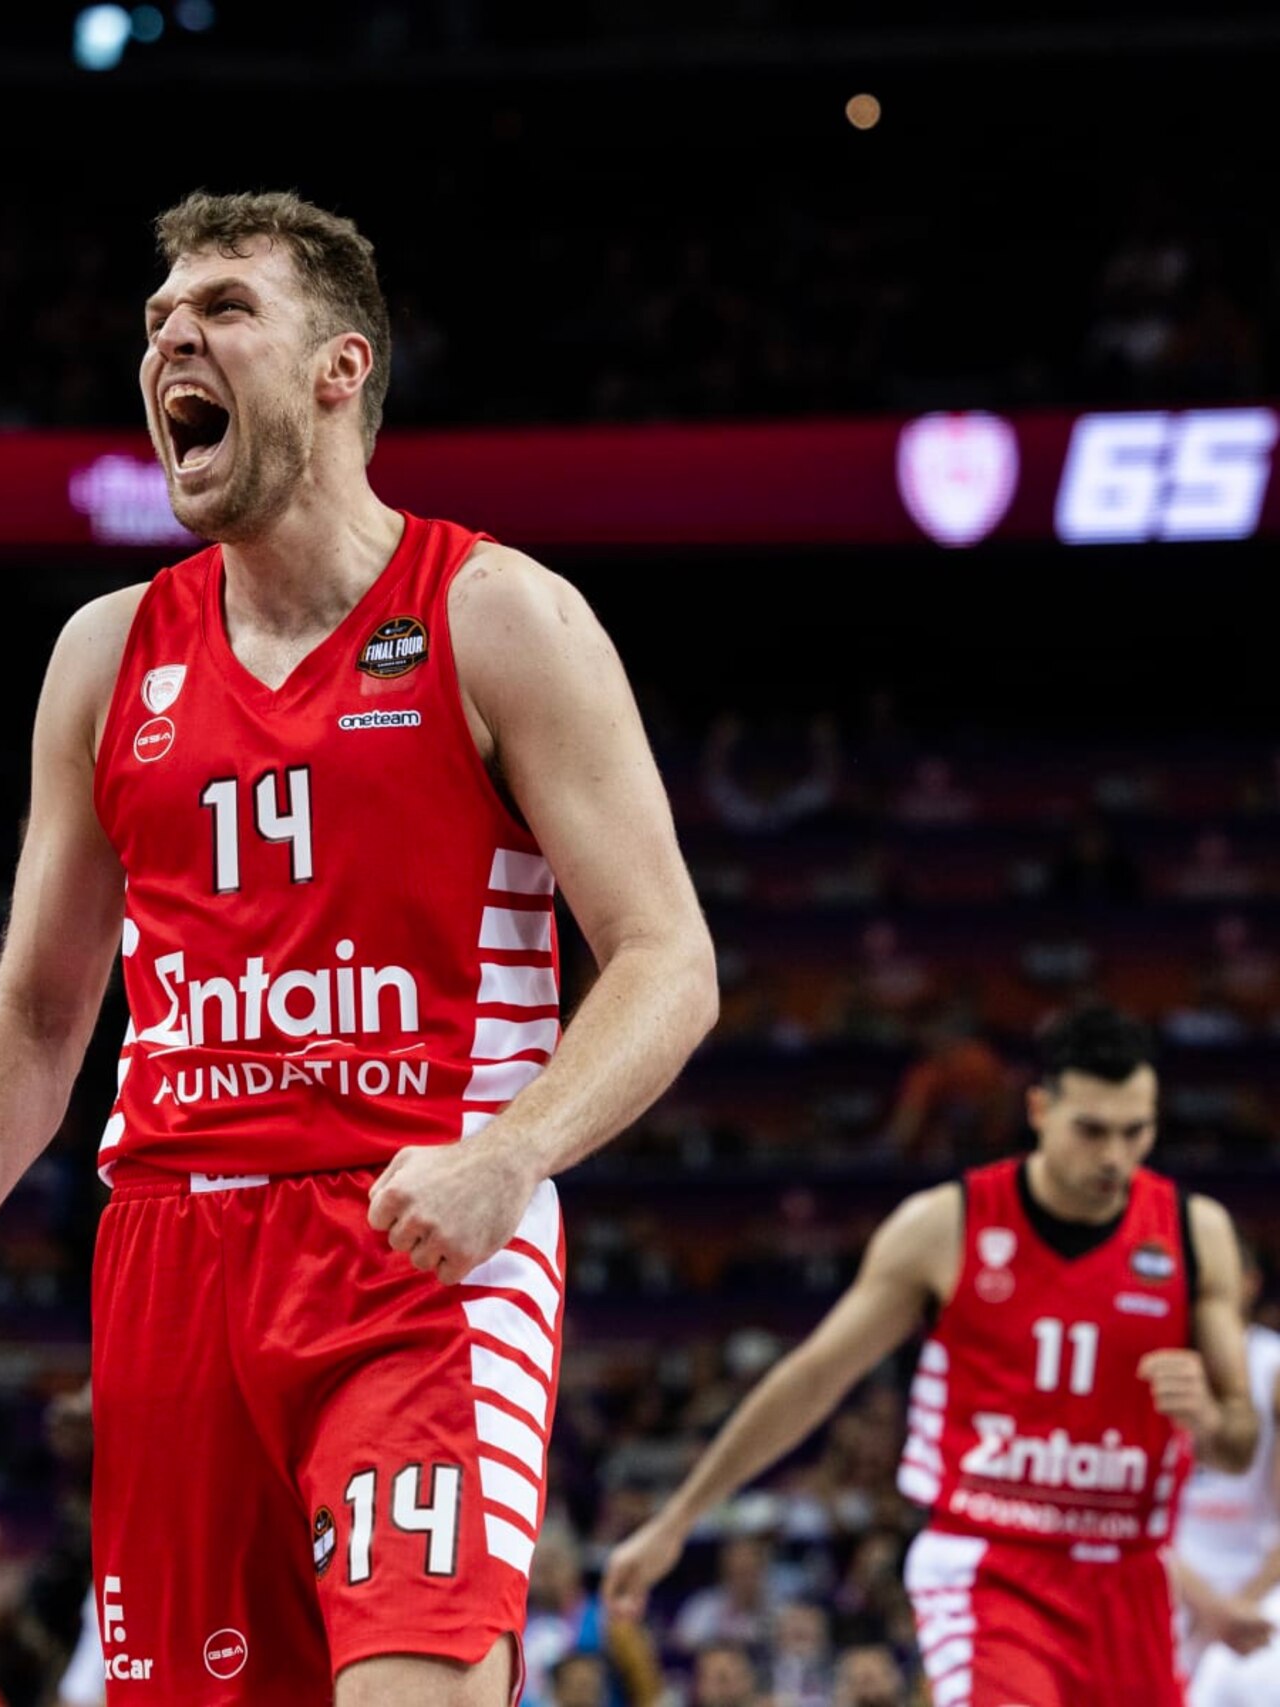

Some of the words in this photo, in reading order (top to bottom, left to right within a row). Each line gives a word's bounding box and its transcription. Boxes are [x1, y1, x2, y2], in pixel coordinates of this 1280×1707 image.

[1055, 408, 1278, 545] 65
[365, 641, 394, 661] FINAL
[395, 635, 423, 658] FOUR
[340, 711, 420, 729] oneteam
[200, 765, 314, 894] 14
[1032, 1316, 1100, 1395] 11
[345, 1463, 463, 1586] 14
